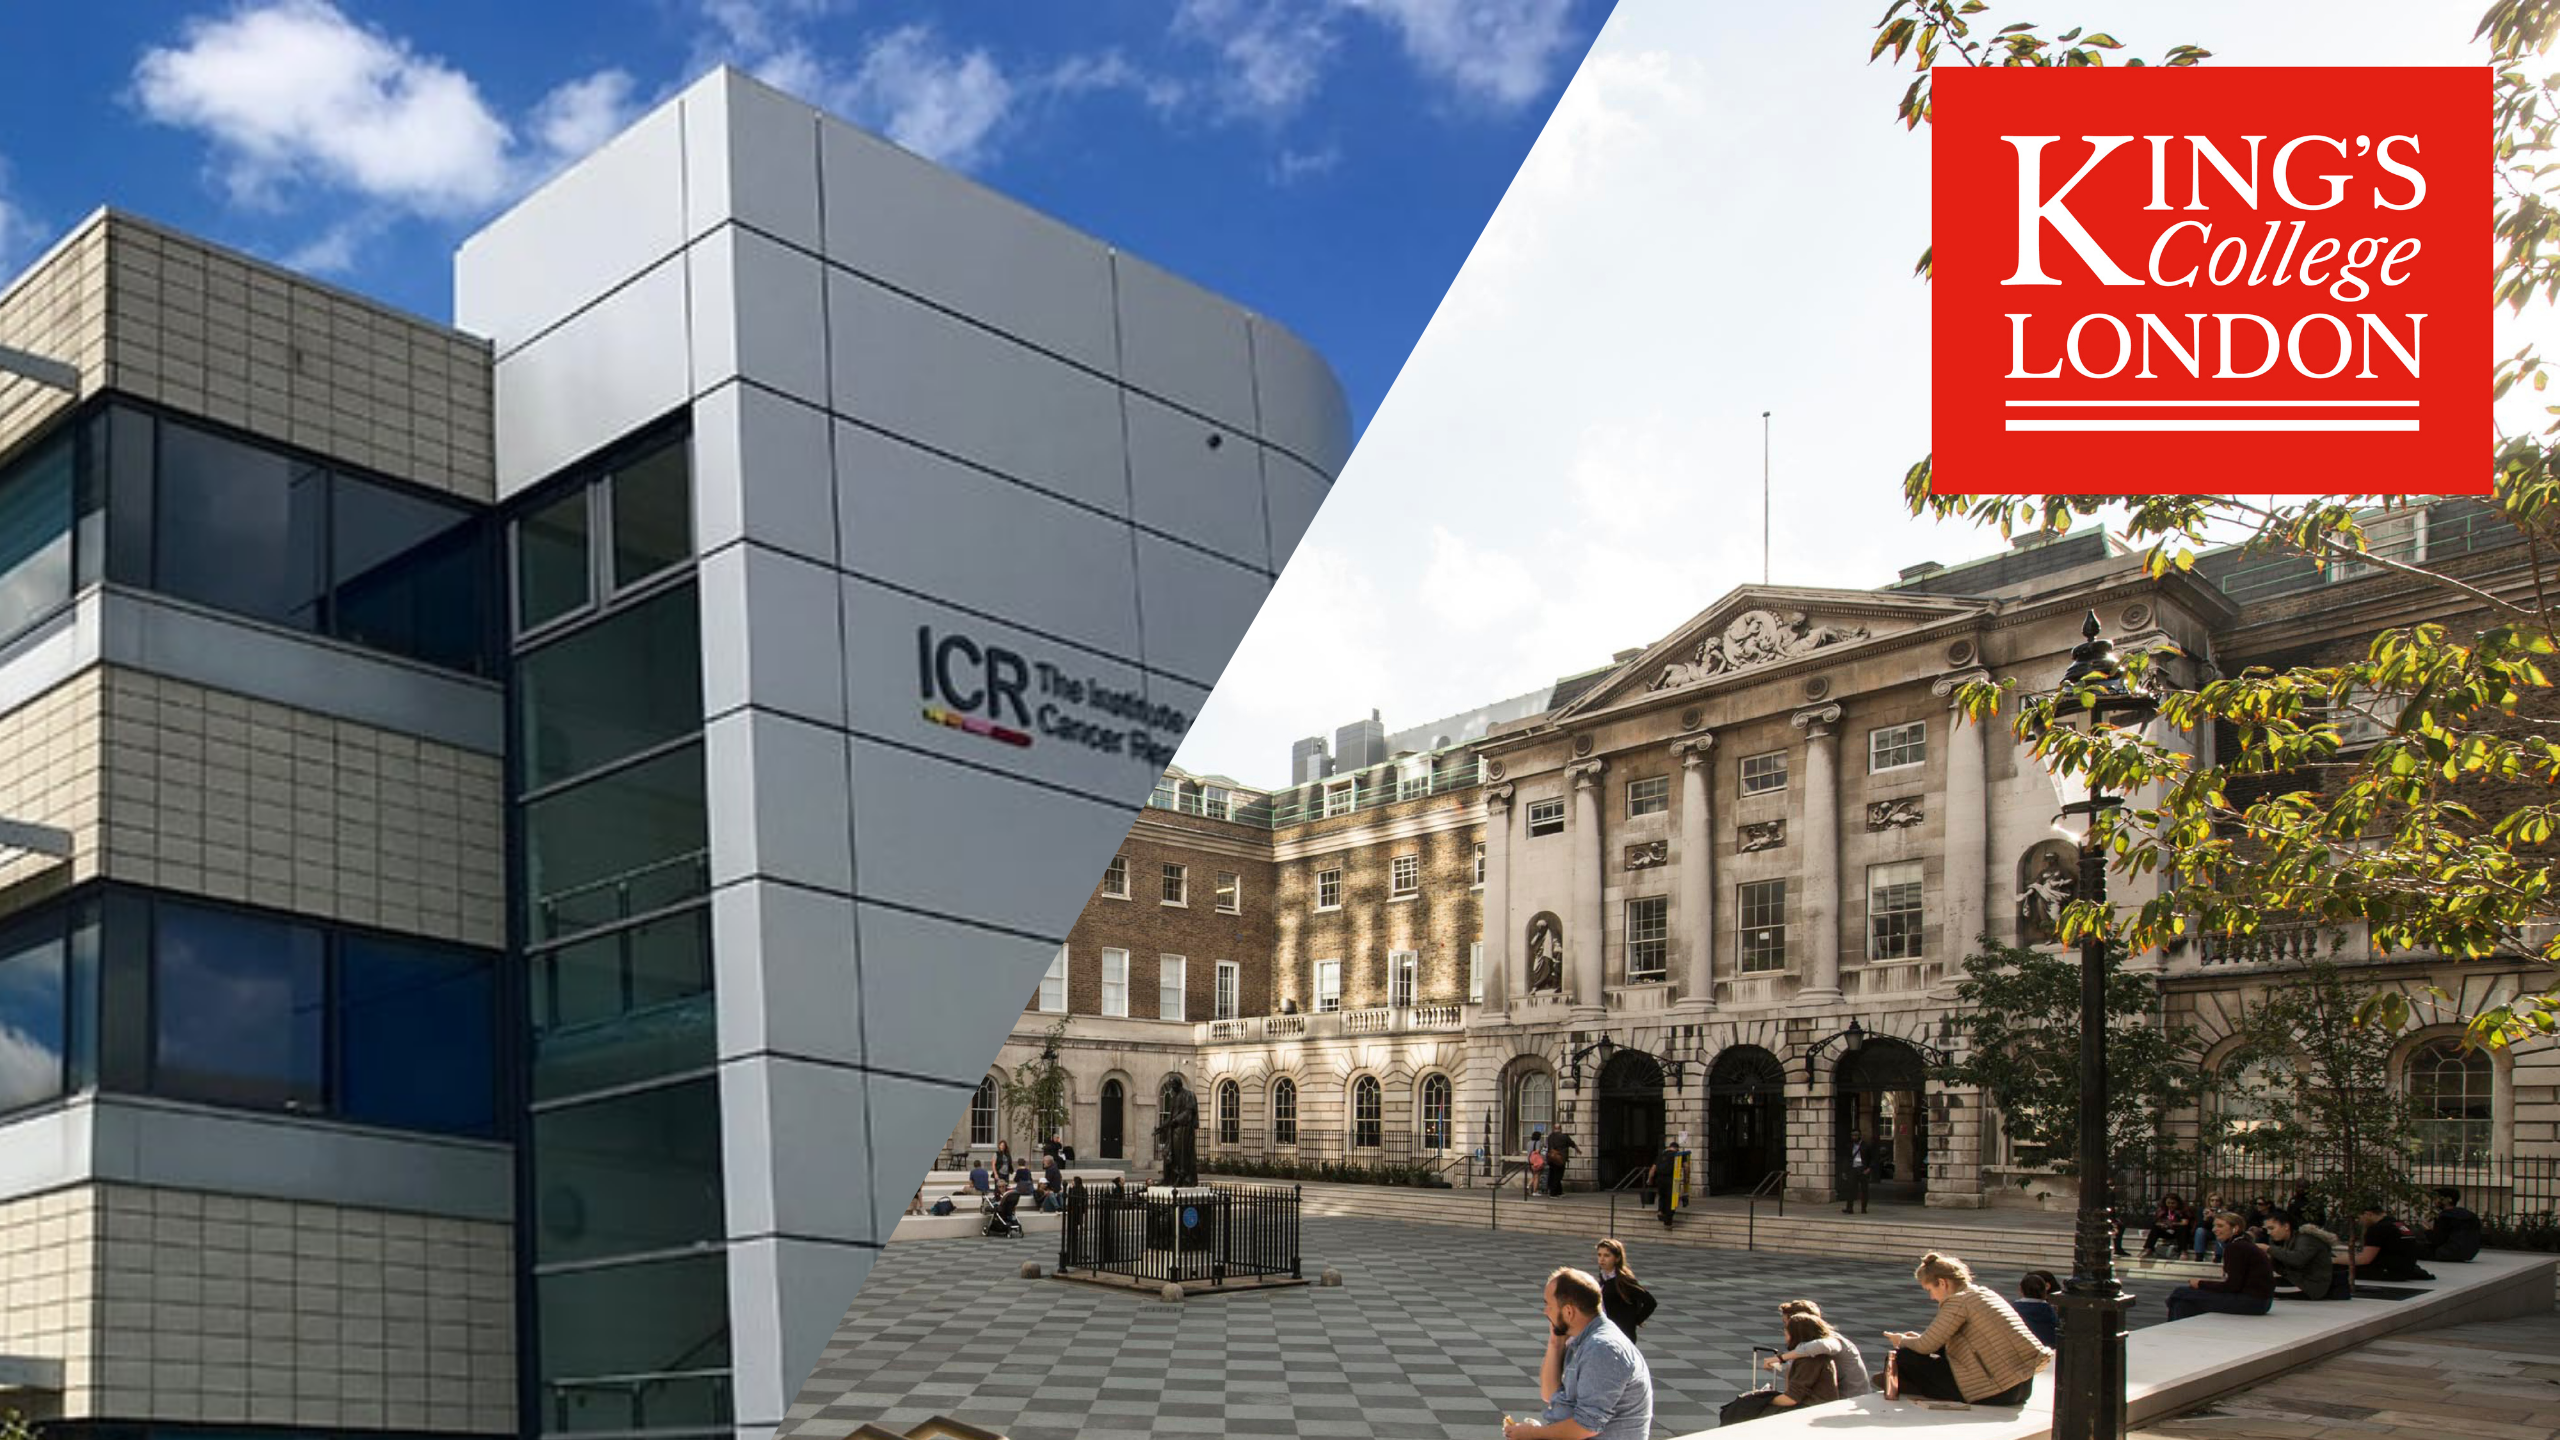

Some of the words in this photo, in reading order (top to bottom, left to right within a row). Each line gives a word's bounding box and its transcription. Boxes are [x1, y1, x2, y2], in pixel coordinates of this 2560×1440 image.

[917, 624, 1032, 728] ICR
[1034, 662, 1083, 704] The
[1087, 678, 1186, 733] Institute
[1037, 703, 1124, 753] Cancer
